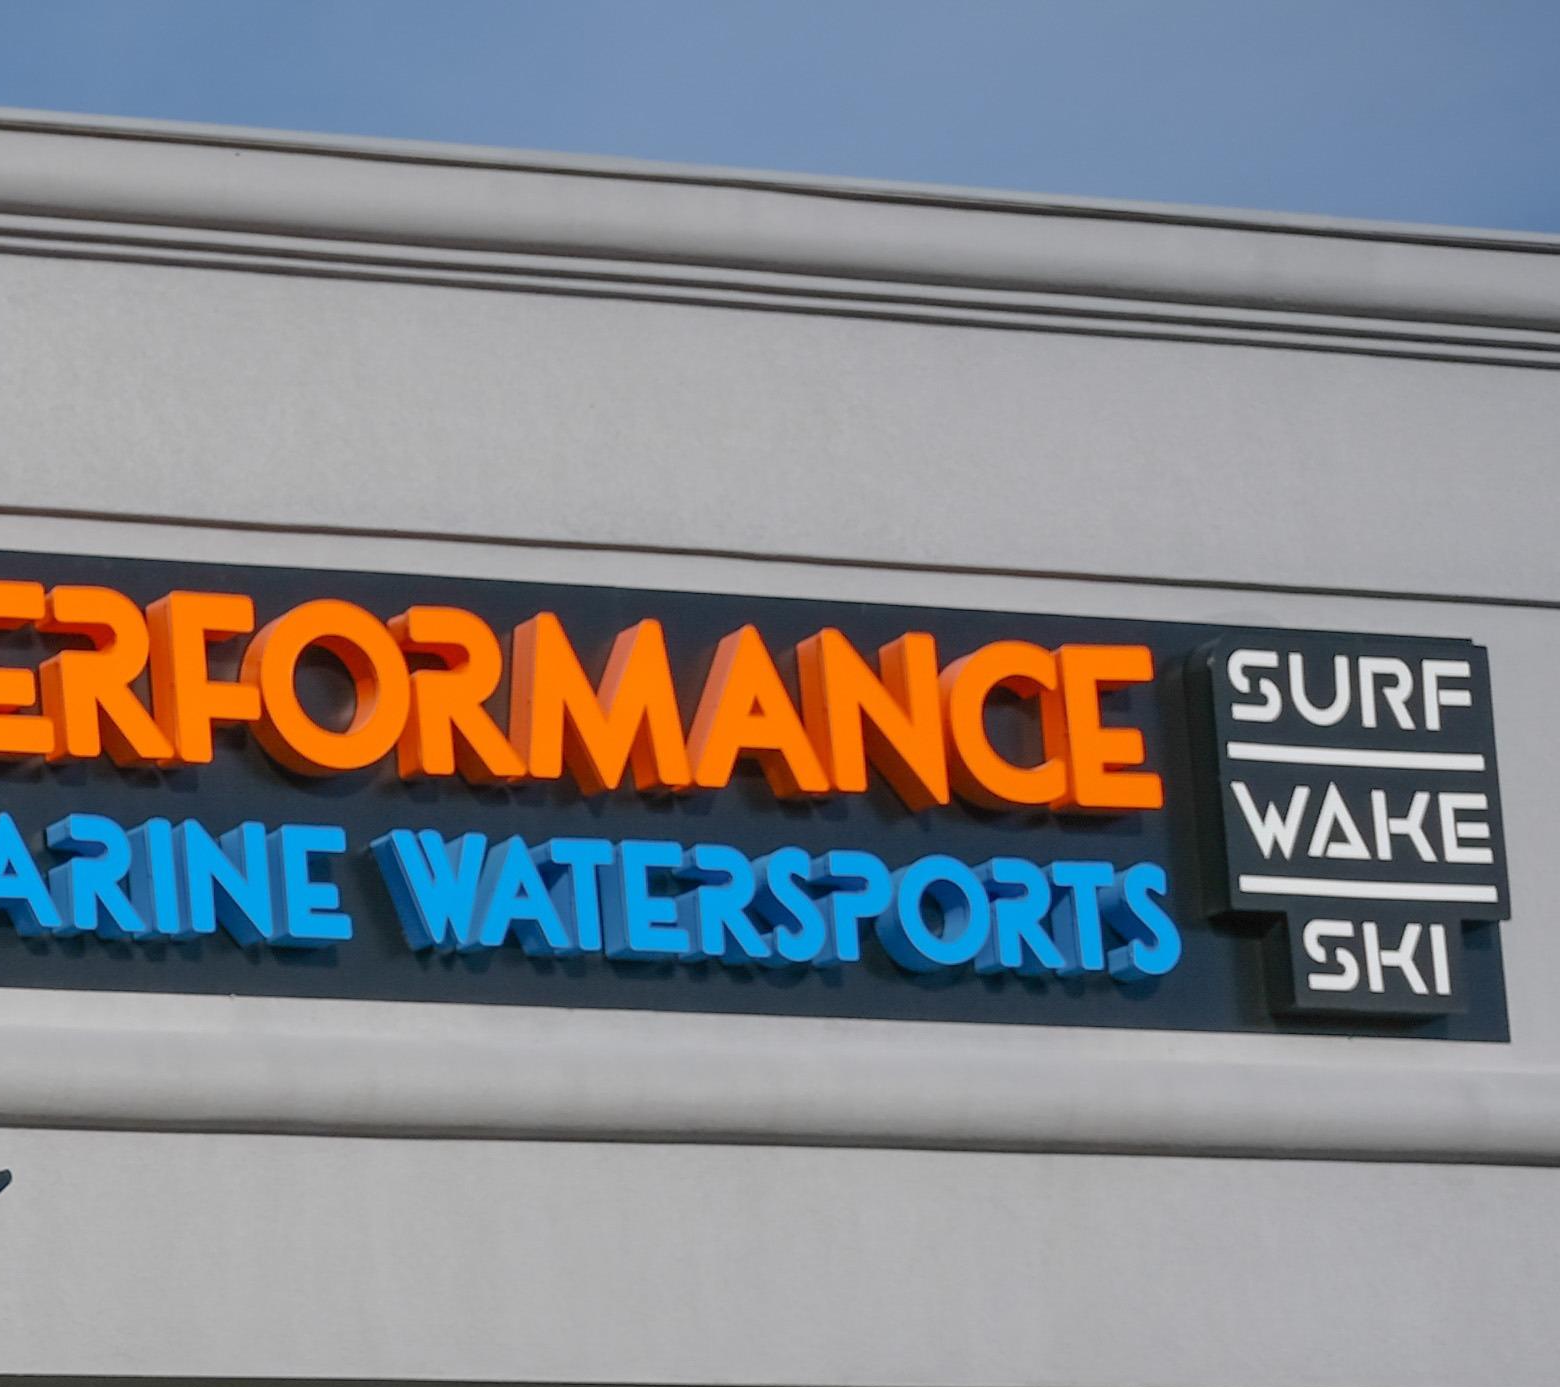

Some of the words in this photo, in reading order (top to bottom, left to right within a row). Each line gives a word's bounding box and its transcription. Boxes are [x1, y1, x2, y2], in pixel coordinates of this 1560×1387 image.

[1226, 645, 1474, 733] SURF
[1237, 779, 1495, 864] WAKE
[371, 827, 1184, 986] WATERSPORTS
[1303, 917, 1454, 997] SKI
